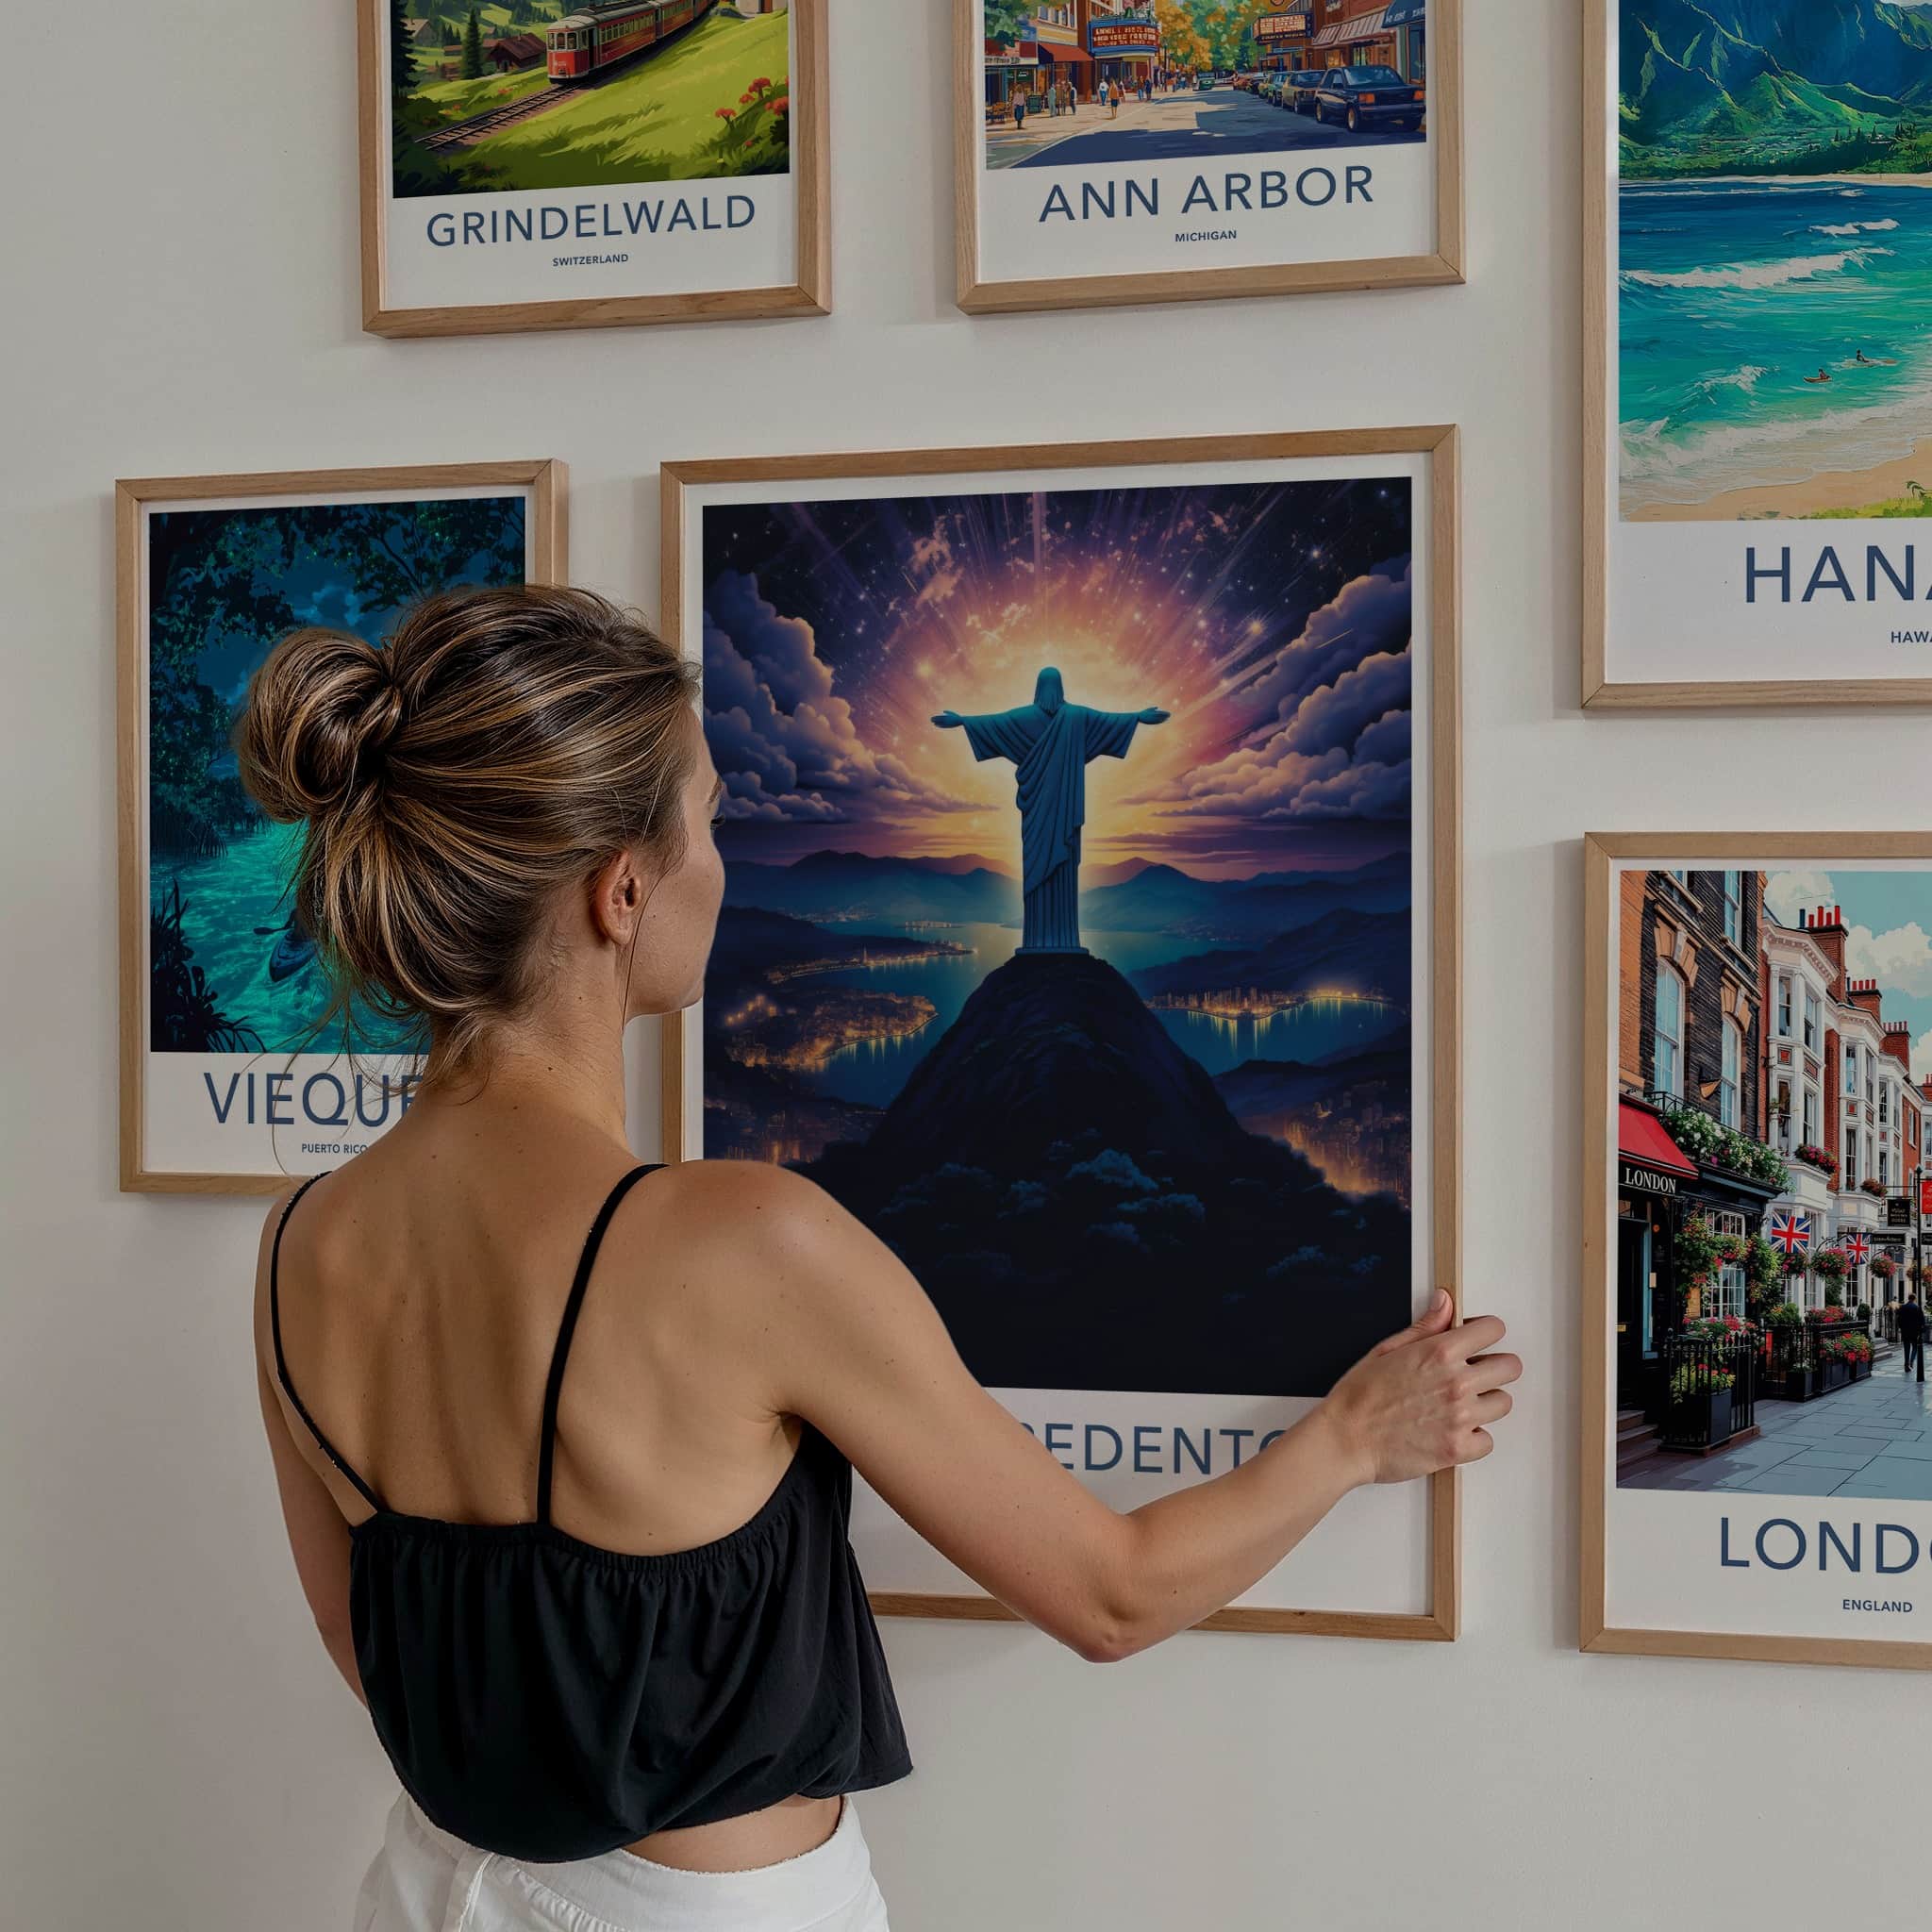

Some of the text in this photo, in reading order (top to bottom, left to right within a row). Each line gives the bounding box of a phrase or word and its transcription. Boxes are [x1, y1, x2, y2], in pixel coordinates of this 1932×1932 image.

[1039, 165, 1374, 223] ANN ARBOR
[426, 194, 756, 247] GRINDELWALD
[1174, 229, 1238, 242] MICHIGAN
[552, 253, 629, 267] SWITZERLAND
[1745, 544, 1932, 603] HAN
[1890, 630, 1932, 643] HAW
[301, 1143, 341, 1154] PUERTO
[1624, 1167, 1676, 1193] LONDON
[1019, 1422, 1287, 1474] EDENT
[1721, 1517, 1932, 1574] LOND
[1842, 1599, 1913, 1613] ENGLAND
